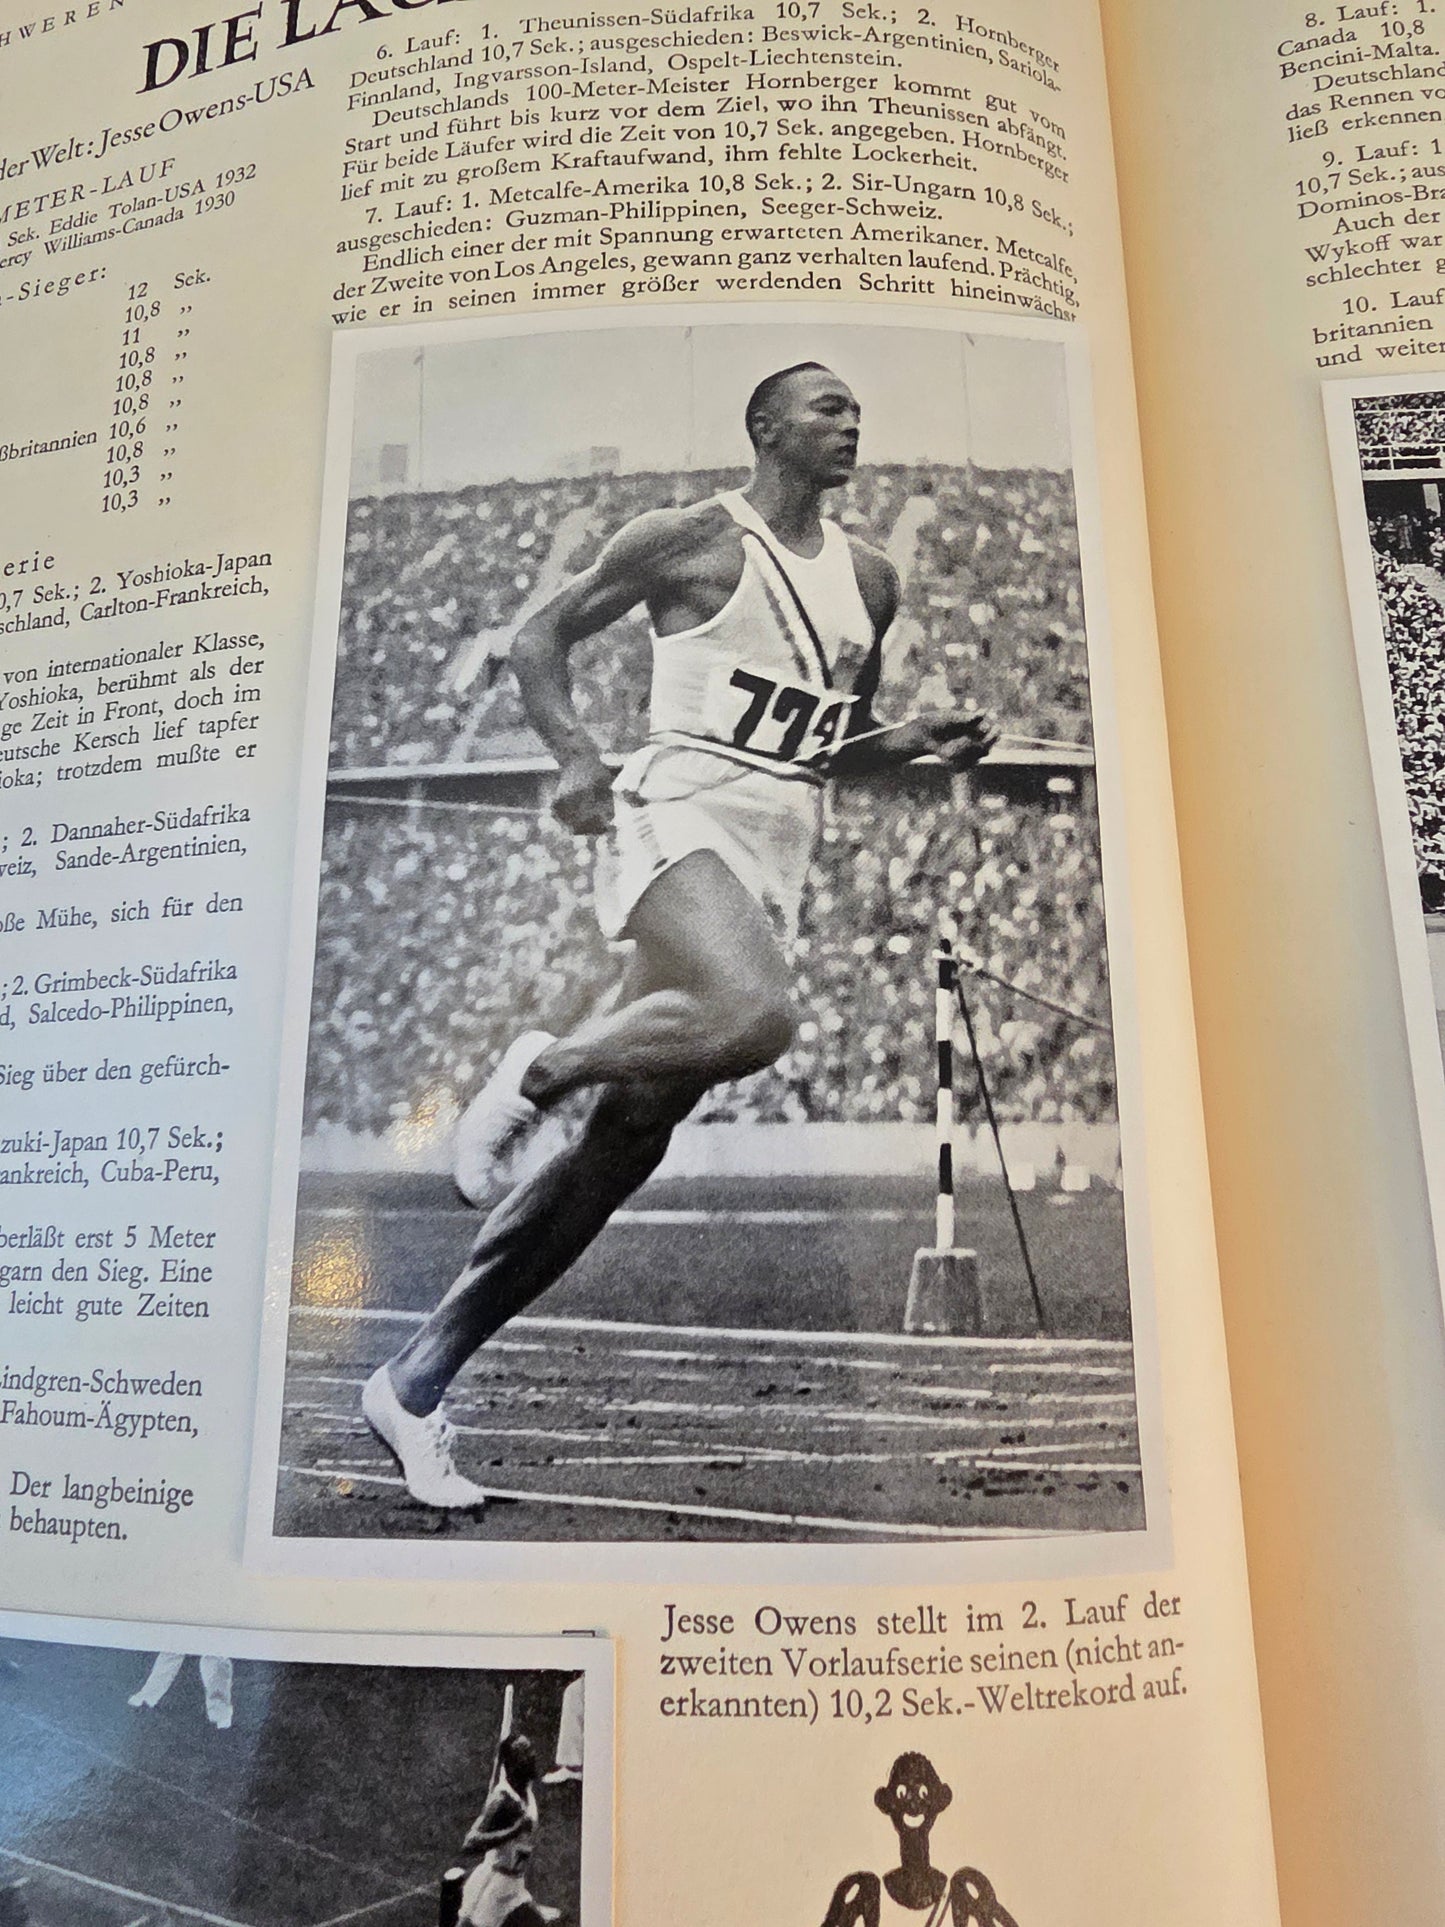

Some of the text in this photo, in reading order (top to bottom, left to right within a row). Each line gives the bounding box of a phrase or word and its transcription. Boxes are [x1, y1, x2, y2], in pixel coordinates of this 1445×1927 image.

[1305, 0, 1398, 28] 8. Lauf:
[136, 2, 262, 94] DIE
[1277, 19, 1425, 57] Canada 10,8
[1279, 41, 1440, 80] Bencini-Malta.
[371, 70, 1017, 128] Deutschlands Hornberger kommt gut
[1285, 90, 1415, 121] das Rennen
[30, 67, 315, 170] Welt: Jesse Owens-USA
[345, 94, 990, 155] Start und führt bis kurz vor dem Ziel, wo ihn Theunissen
[1287, 119, 1329, 143] ließ
[342, 118, 955, 179] Für beide Läufer wird die Zeit von 10,7 Sek. angegeben.
[1322, 140, 1418, 168] 9. Lauf:
[340, 142, 977, 202] lief mit zu großem Kraftaufwand, ihm fehlte Lockerheit.
[1296, 165, 1407, 197] 10,7 Sek.;
[7, 163, 256, 247] Sek. Eddie Tolan-USA 1932
[1332, 207, 1441, 236] Auch der
[43, 190, 235, 255] Williams-Canada 1930
[362, 221, 989, 273] Endlich einer der mit Spannung erwarteten Amerikaner.
[1304, 233, 1392, 264] Wykoff
[128, 268, 211, 301] 12 Sek.
[1306, 258, 1422, 287] schlechter
[125, 300, 161, 324] 10,8
[331, 270, 935, 325] wie er in seinen immer größer werdenden Schritt
[1342, 296, 1377, 315] 10.
[122, 327, 140, 346] 11
[1312, 315, 1434, 345] britannien
[119, 346, 155, 369] 10,8
[1315, 344, 1363, 368] und
[115, 369, 152, 393] 10,8
[113, 393, 149, 416] 10,8
[109, 416, 146, 440] 10,6
[106, 440, 143, 464] 10,8
[103, 465, 140, 489] 10,3
[102, 489, 138, 513] 10,3
[32, 553, 272, 604] Sek.; 2. Yoshioka-Japan
[80, 574, 269, 621] Carlton-Frankreich,
[3, 632, 264, 684] von internationaler Klasse,
[97, 655, 265, 696] berühmt als der
[30, 683, 261, 732] Zeit in Front, doch im
[72, 710, 259, 753] Kersch lief tapfer
[57, 743, 257, 781] trotzdem mußte er
[20, 803, 251, 847] 2. Dannaher-Südafrika
[55, 836, 247, 870] Sande-Argentinien,
[36, 891, 243, 930] Mühe, sich für den
[11, 959, 238, 996] 2. Grimbeck-Südafrika
[28, 994, 233, 1024] Salcedo-Philippinen,
[43, 1053, 230, 1085] über den gefürch-
[117, 1125, 223, 1155] 10,7 Sek.;
[101, 1158, 219, 1186] Cuba-Peru,
[75, 1225, 216, 1249] erst 5 Meter
[51, 1258, 212, 1290] den Sieg. Eine
[8, 1290, 210, 1322] leicht gute Zeiten
[9, 1471, 194, 1514] Der langbeinige
[10, 1505, 127, 1544] behaupten.
[660, 1590, 1181, 1643] Jesse Owens stellt im 2. Lauf der
[660, 1634, 1184, 1677] zweiten Vorlaufserie seinen (nicht an-
[660, 1687, 819, 1726] erkannten)
[830, 1688, 892, 1725] 10,2
[1143, 1666, 1187, 1700] auf.
